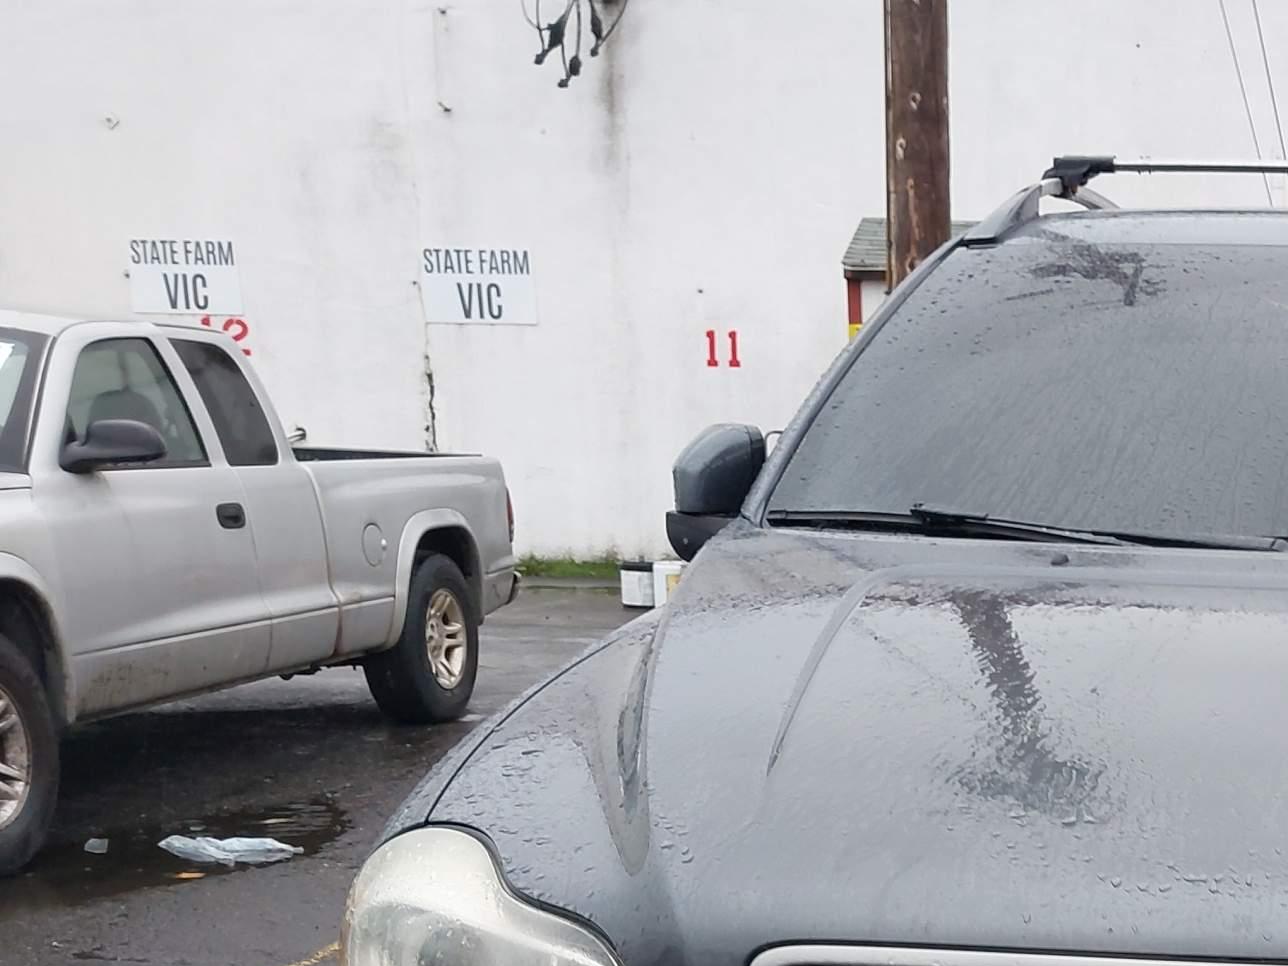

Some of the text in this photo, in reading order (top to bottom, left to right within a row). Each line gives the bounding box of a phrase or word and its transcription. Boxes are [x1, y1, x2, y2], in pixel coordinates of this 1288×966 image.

[130, 239, 235, 267] STATE FARM
[422, 248, 531, 276] STATE FARM
[162, 272, 209, 311] VIC
[456, 282, 503, 320] VIC
[705, 329, 741, 369] 11
